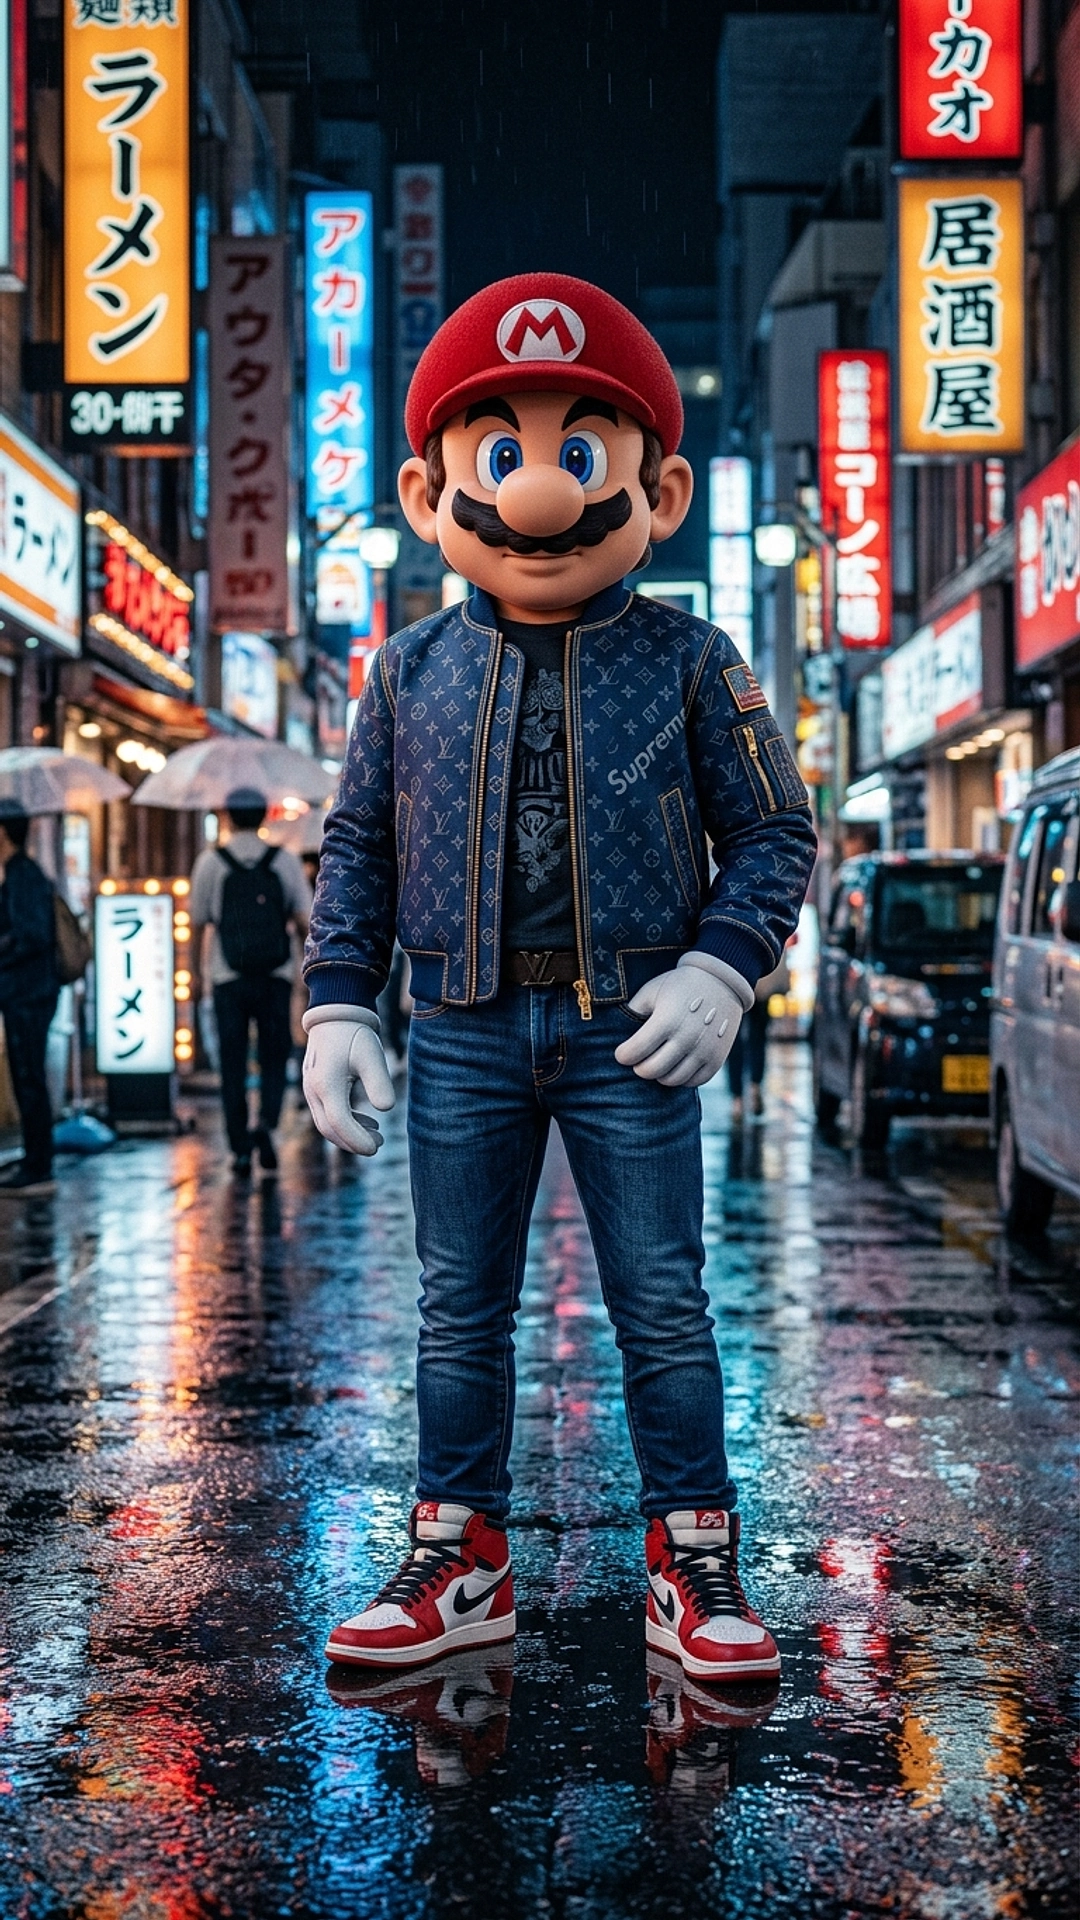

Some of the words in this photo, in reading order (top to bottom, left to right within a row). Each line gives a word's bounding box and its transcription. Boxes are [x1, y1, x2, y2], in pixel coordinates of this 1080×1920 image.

[929, 0, 991, 140] カオ
[86, 49, 165, 361] ラーメン
[314, 209, 365, 493] アカーメケ
[504, 305, 578, 357] M
[921, 197, 1001, 433] 居酒屋
[112, 906, 145, 1060] ラーメン
